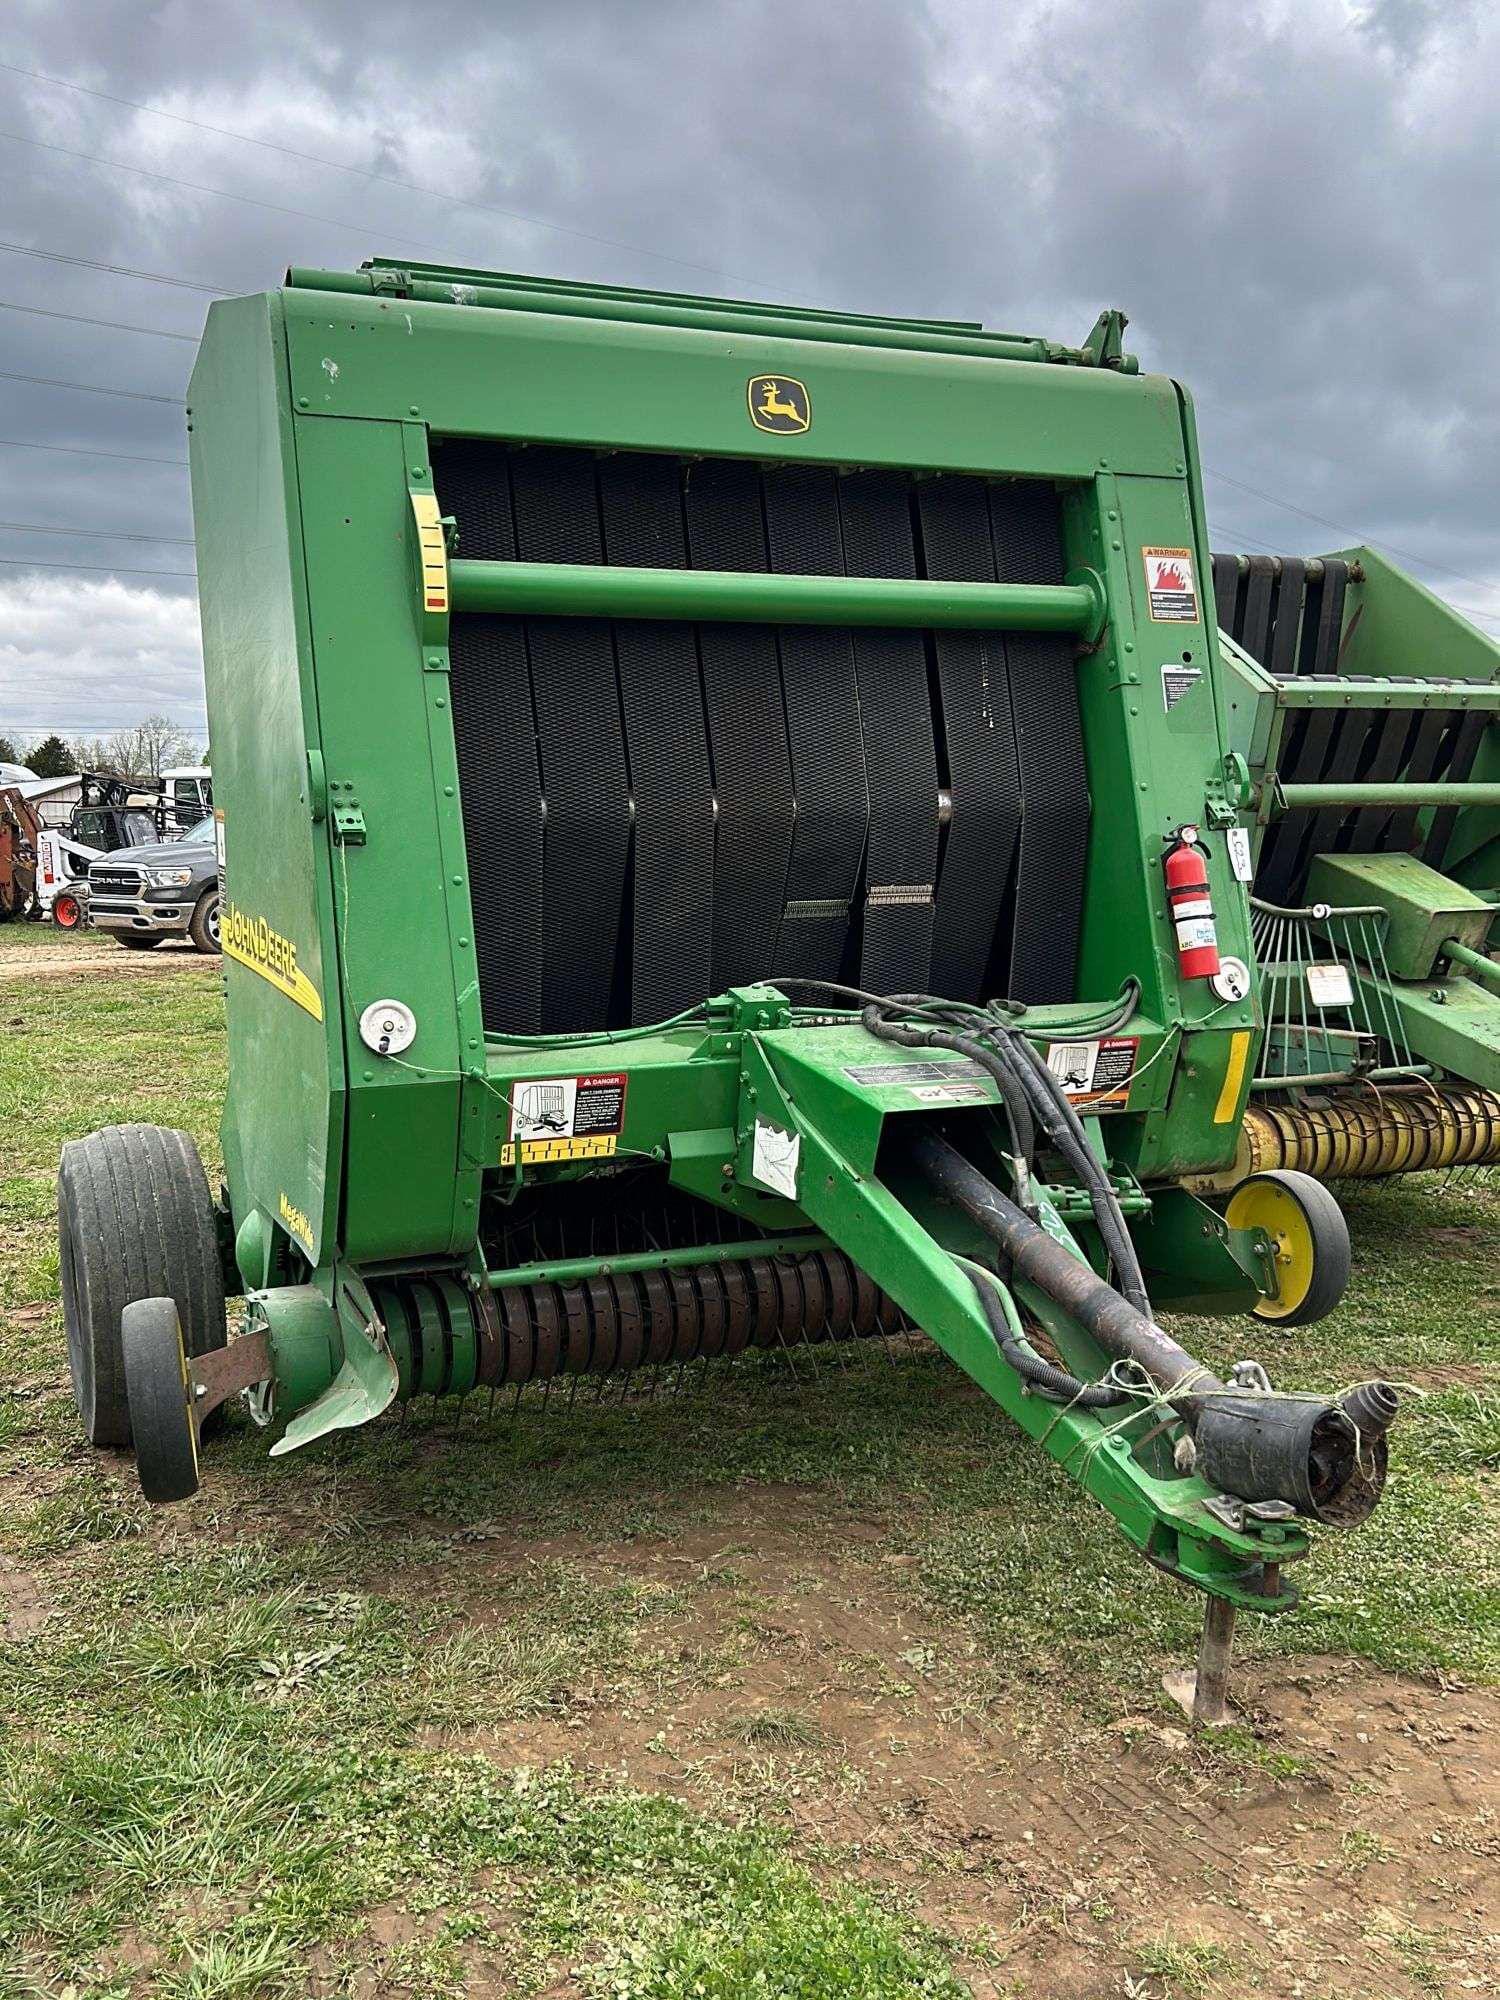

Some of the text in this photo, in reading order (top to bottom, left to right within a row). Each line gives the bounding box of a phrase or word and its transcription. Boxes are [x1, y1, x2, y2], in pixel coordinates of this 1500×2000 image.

[1154, 548, 1187, 557] WARNING
[228, 901, 297, 982] JOHN DEERE
[592, 1077, 619, 1086] DANGER
